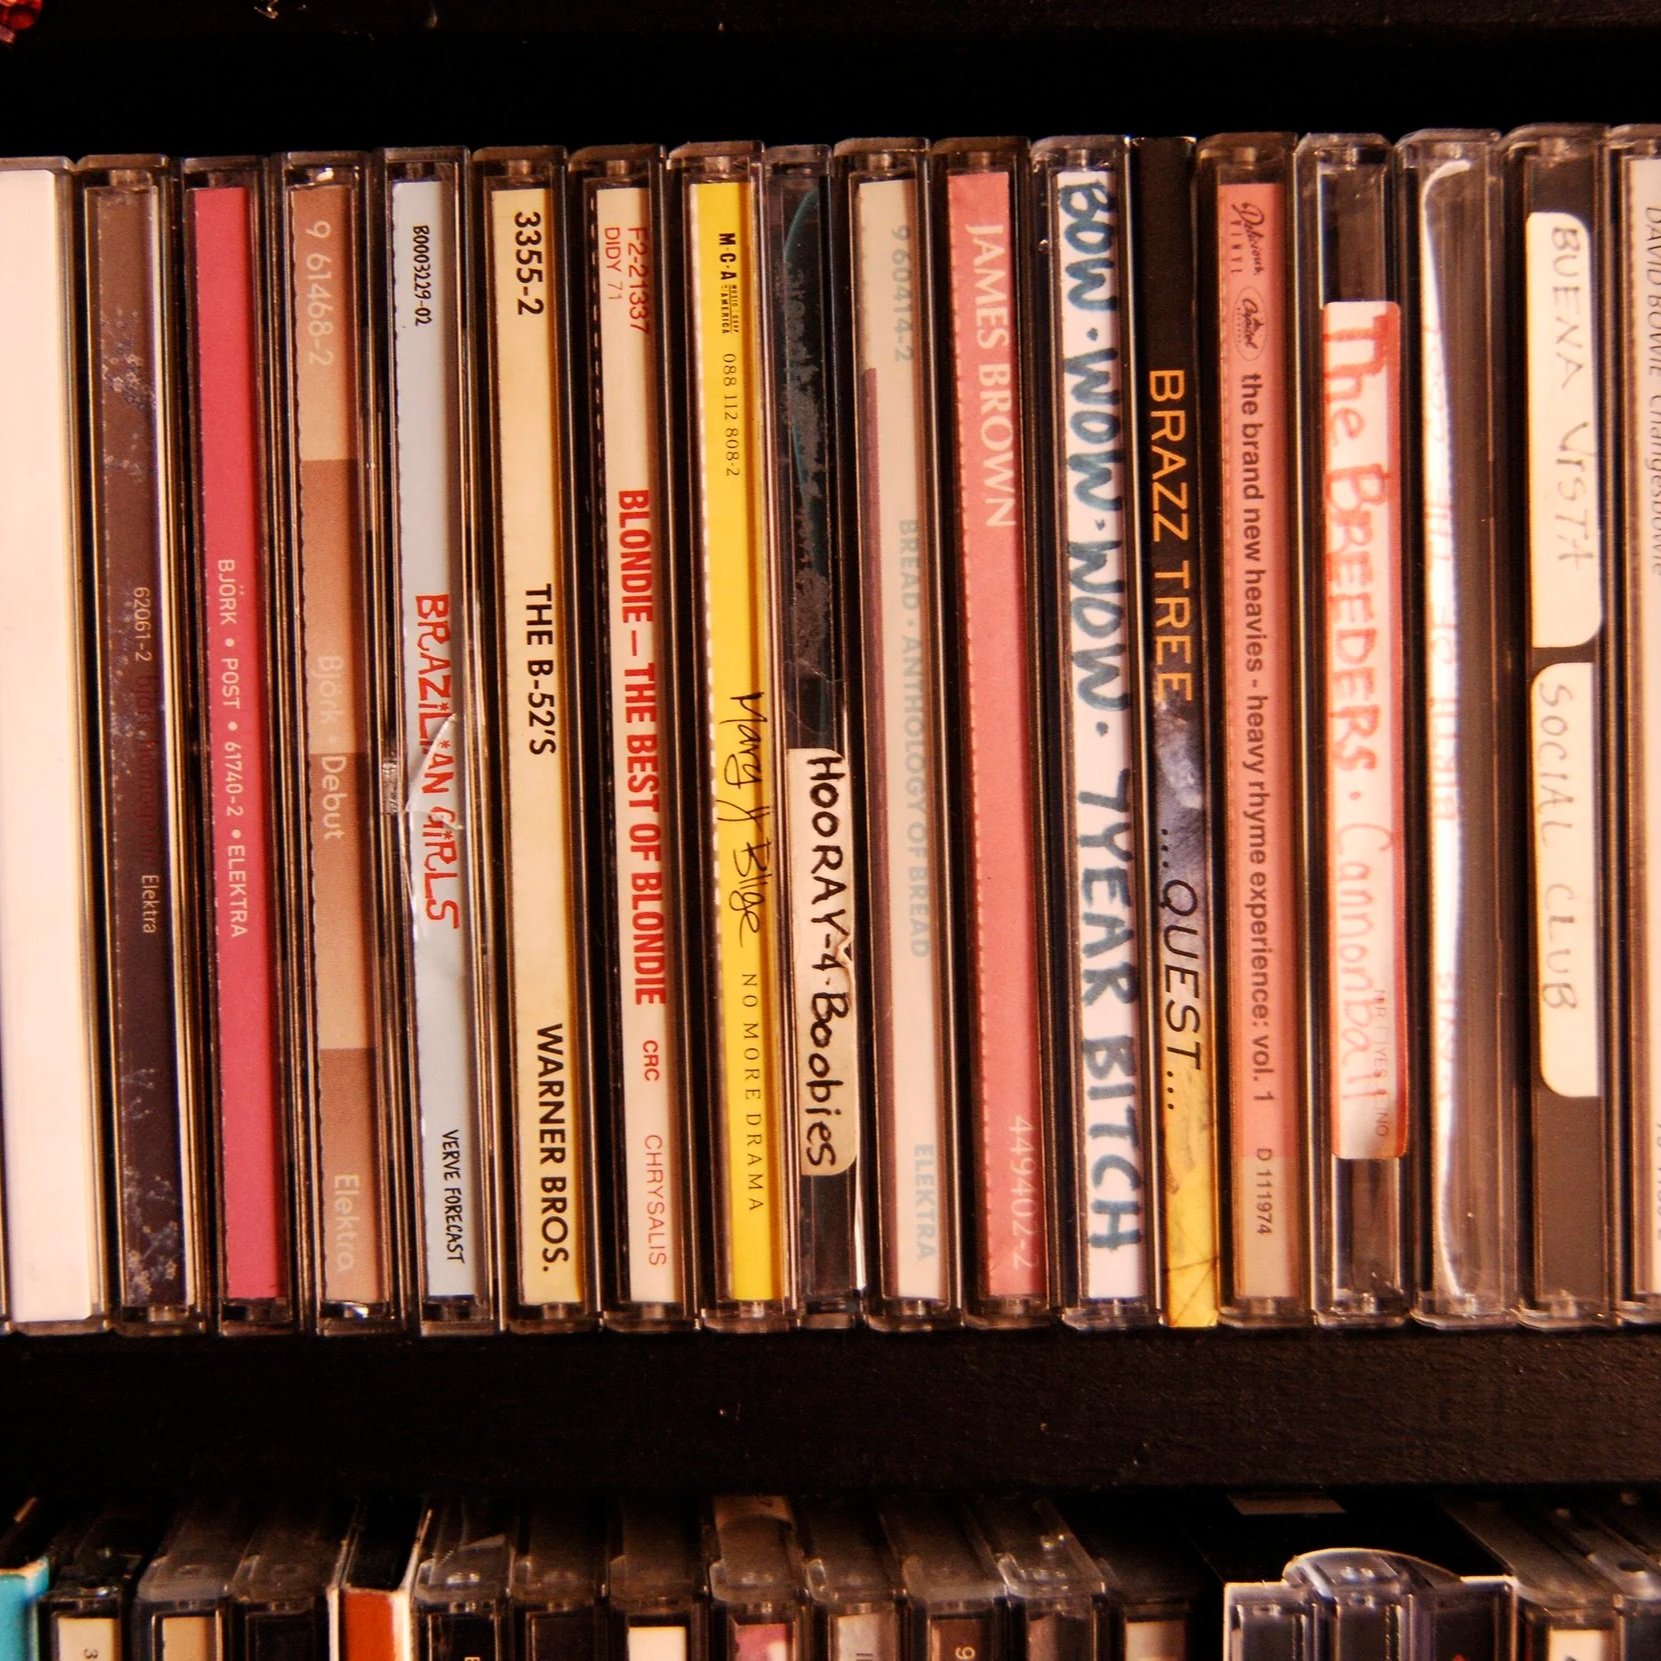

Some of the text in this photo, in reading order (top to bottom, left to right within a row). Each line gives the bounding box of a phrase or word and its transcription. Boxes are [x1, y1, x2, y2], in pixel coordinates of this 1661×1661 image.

[308, 221, 334, 366] 9 61468-2
[411, 225, 433, 327] B0003229-02
[514, 212, 544, 315] 3355-2
[604, 226, 623, 300] DIDY 71
[627, 226, 650, 334] F2-21337
[891, 225, 913, 363] 9 60414-2
[1061, 182, 1117, 313] BOW
[1552, 225, 1584, 389] BUENA
[723, 353, 740, 477] 088 112 808-2
[965, 224, 1016, 527] JAMES BROWN
[1065, 348, 1124, 511] WOW
[1241, 373, 1263, 415] the
[1242, 423, 1265, 499] brand
[618, 491, 653, 623] BLONDIE
[1149, 369, 1193, 704] BRAZZ TREE
[1244, 508, 1262, 560] new
[133, 587, 153, 661] 62061-2
[525, 584, 555, 754] THE B-52'S
[1067, 540, 1130, 711] WOW
[1244, 569, 1268, 672] heavies
[625, 663, 656, 722] THE
[720, 692, 768, 789] Mary
[898, 519, 930, 958] BREAD ANTHOLOGY OF BREAD
[1242, 695, 1270, 773] heavy
[1323, 313, 1394, 1103] The BREEDERS Cannonball
[218, 560, 247, 938] BJÖRK POST 61740-2 ELEKTRA
[320, 756, 346, 840] Debut
[626, 735, 661, 811] BEST
[630, 824, 662, 861] OF
[1243, 781, 1269, 864] rhyme
[1538, 682, 1578, 1011] SOCIAL CLUB
[141, 875, 159, 933] Elektra
[632, 872, 666, 1006] BLONDIE
[729, 840, 772, 948] Blige
[1244, 871, 1272, 1028] experience:
[642, 1040, 660, 1081] CRC
[741, 974, 765, 1213] NO MORE DRAMA
[1250, 1035, 1275, 1082] vol.
[1252, 1090, 1275, 1102] 1
[537, 1024, 568, 1273] WARNER BROS.
[1082, 1036, 1145, 1251] BITCH
[1375, 1113, 1389, 1136] NO
[333, 1174, 360, 1272] Elektra
[442, 1129, 464, 1264] VERVE FORECAST
[644, 1135, 666, 1266] CHRYSALIS
[913, 1143, 936, 1260] ELEKTRA
[1007, 1115, 1039, 1270] 449402-2
[1256, 1149, 1272, 1235] D 111974
